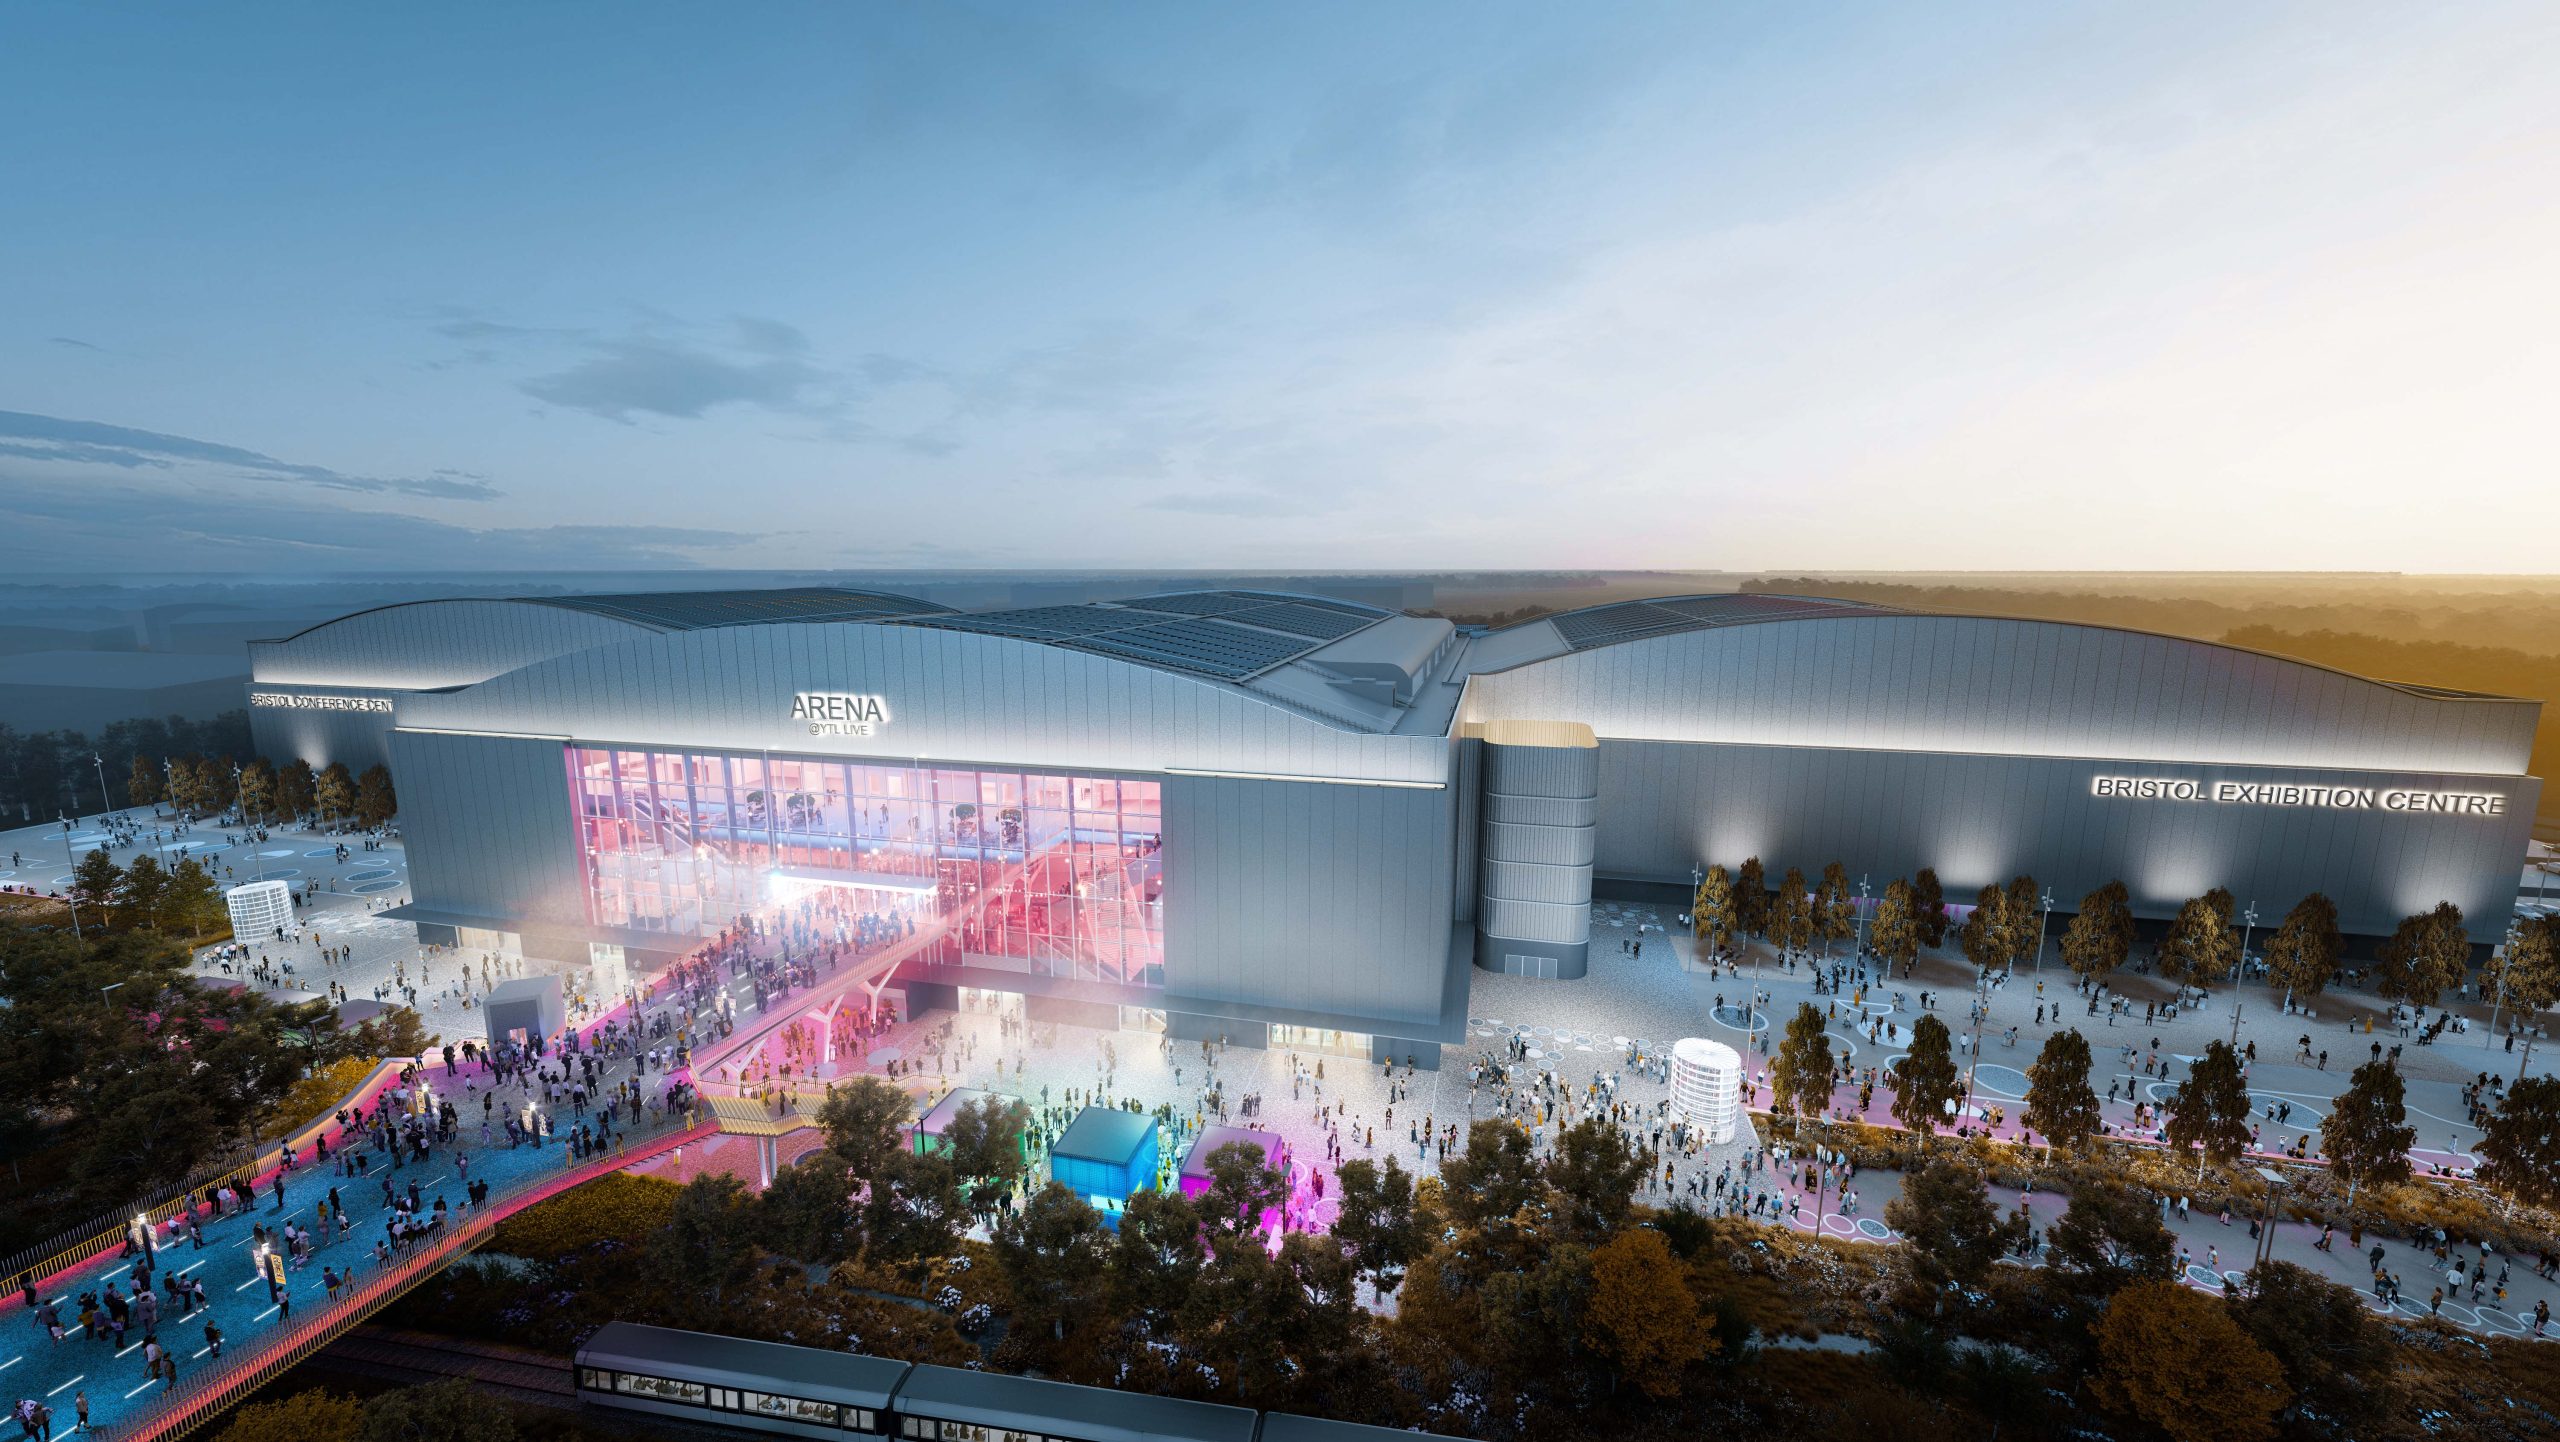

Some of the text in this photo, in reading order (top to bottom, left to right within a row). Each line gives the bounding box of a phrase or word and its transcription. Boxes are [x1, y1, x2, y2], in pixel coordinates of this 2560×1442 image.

[250, 694, 292, 707] BRISTOL
[294, 696, 365, 711] CONFERENCE
[790, 695, 884, 722] ARENA
[808, 723, 868, 736] @YTL LIVE
[2097, 778, 2508, 815] BRISTOL EXHIBITION CENTRE
